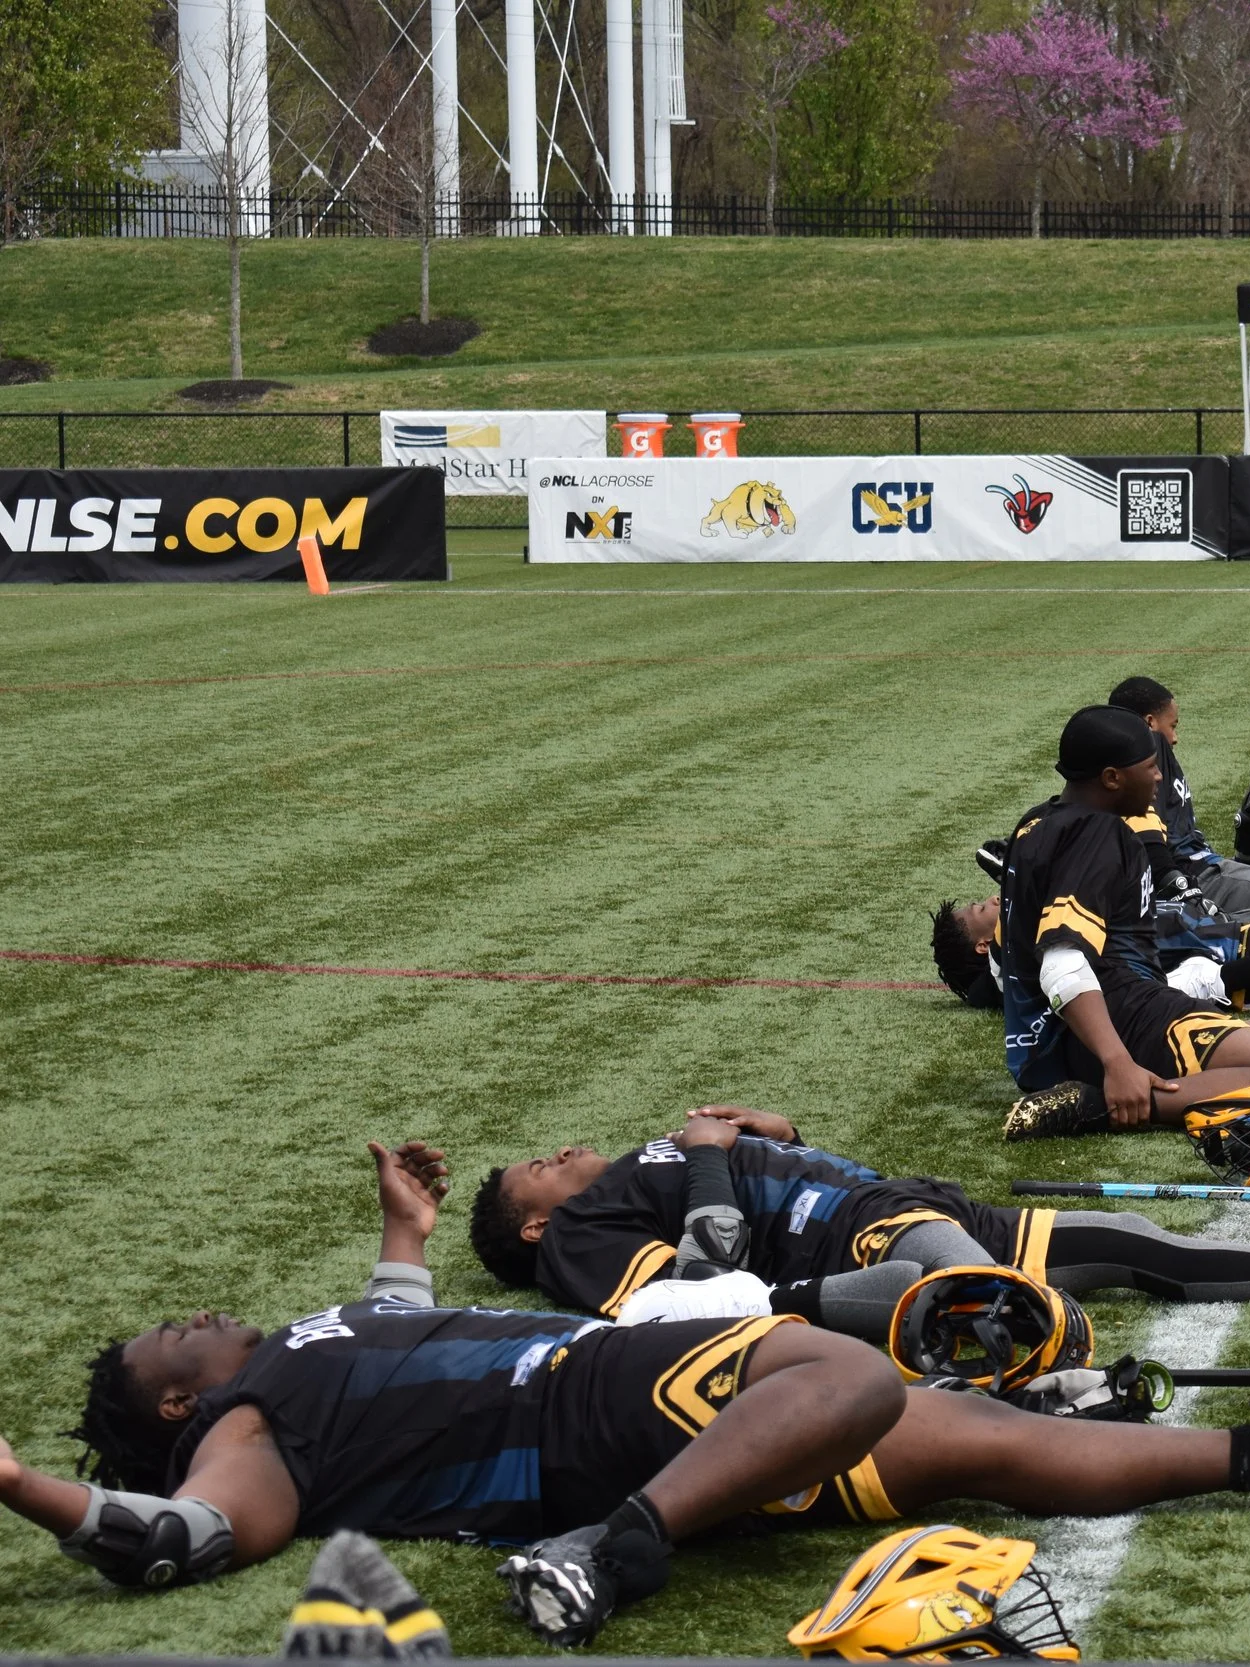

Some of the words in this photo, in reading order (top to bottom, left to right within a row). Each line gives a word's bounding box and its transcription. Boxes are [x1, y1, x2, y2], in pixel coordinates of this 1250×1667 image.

[630, 431, 650, 452] G
[704, 430, 722, 451] G
[592, 496, 605, 504] ON
[852, 482, 934, 534] CSU
[565, 506, 632, 539] NXT
